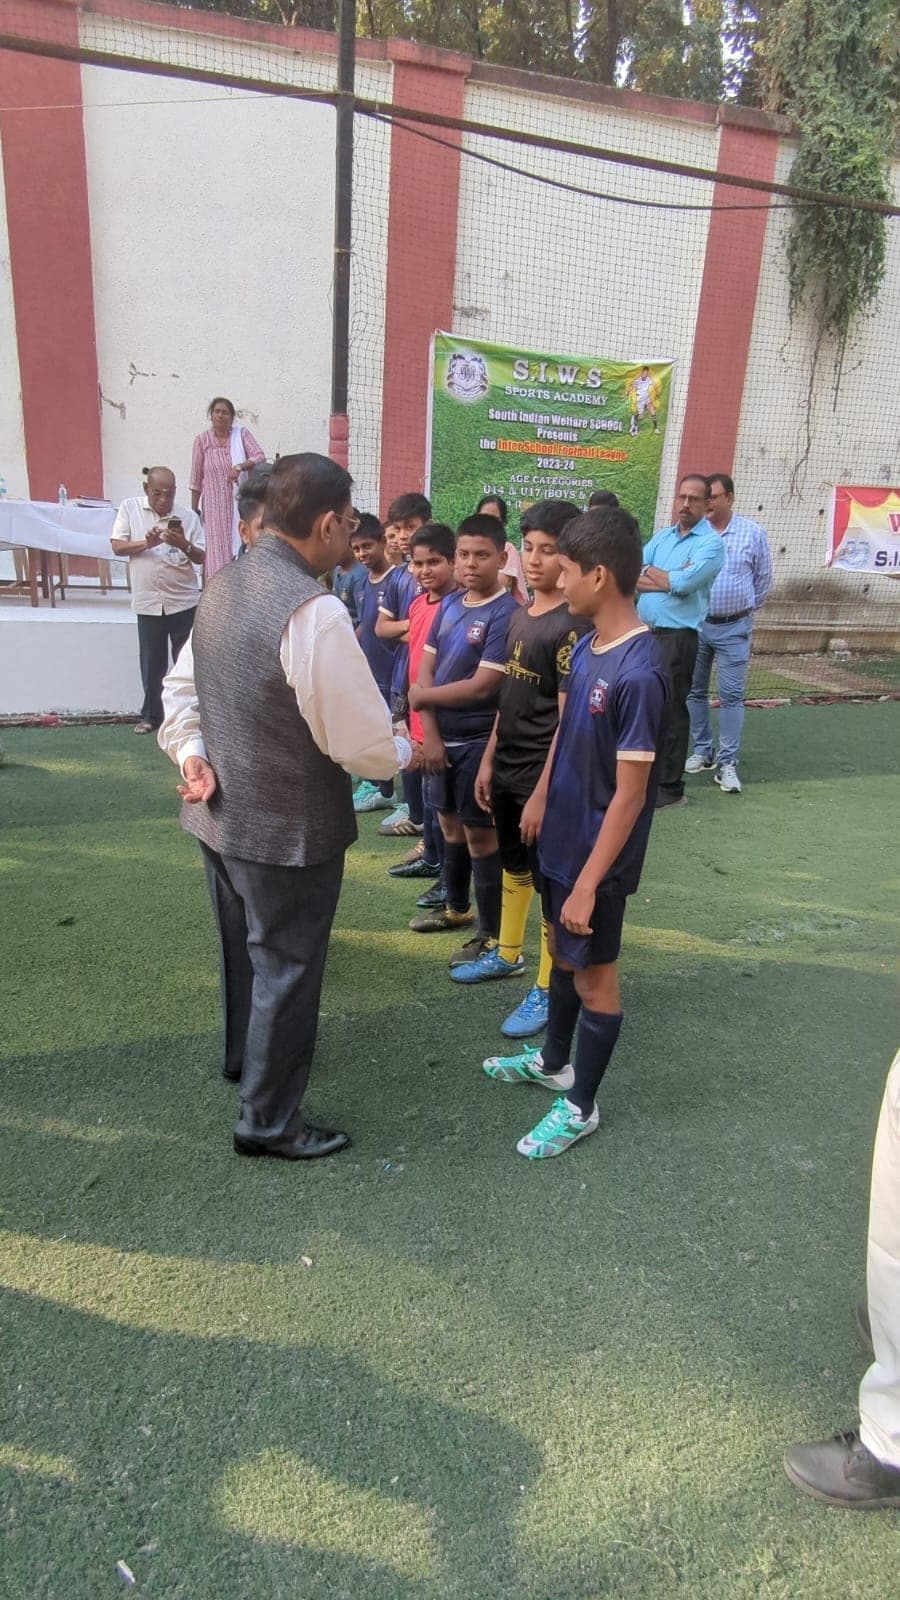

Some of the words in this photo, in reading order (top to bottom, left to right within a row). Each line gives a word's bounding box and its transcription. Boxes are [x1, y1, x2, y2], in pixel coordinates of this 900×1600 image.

[505, 386, 550, 400] SPORTS
[553, 391, 608, 406] ACADEMY
[488, 408, 517, 421] South
[519, 411, 549, 424] Indian
[551, 415, 587, 428] Welfare
[589, 419, 622, 432] SCHOOL
[537, 428, 578, 441] Presents
[479, 438, 496, 450] the
[498, 439, 523, 451] Inter
[524, 441, 556, 454] School
[558, 444, 595, 457] Football
[596, 449, 627, 461] League
[537, 457, 575, 471] 2023-24
[509, 474, 529, 483] AGE
[532, 476, 593, 487] CATEGORIES
[483, 485, 504, 494] U14
[508, 487, 516, 496] &
[521, 487, 540, 497] U17
[544, 488, 576, 500] (BOYS
[578, 490, 586, 499] &
